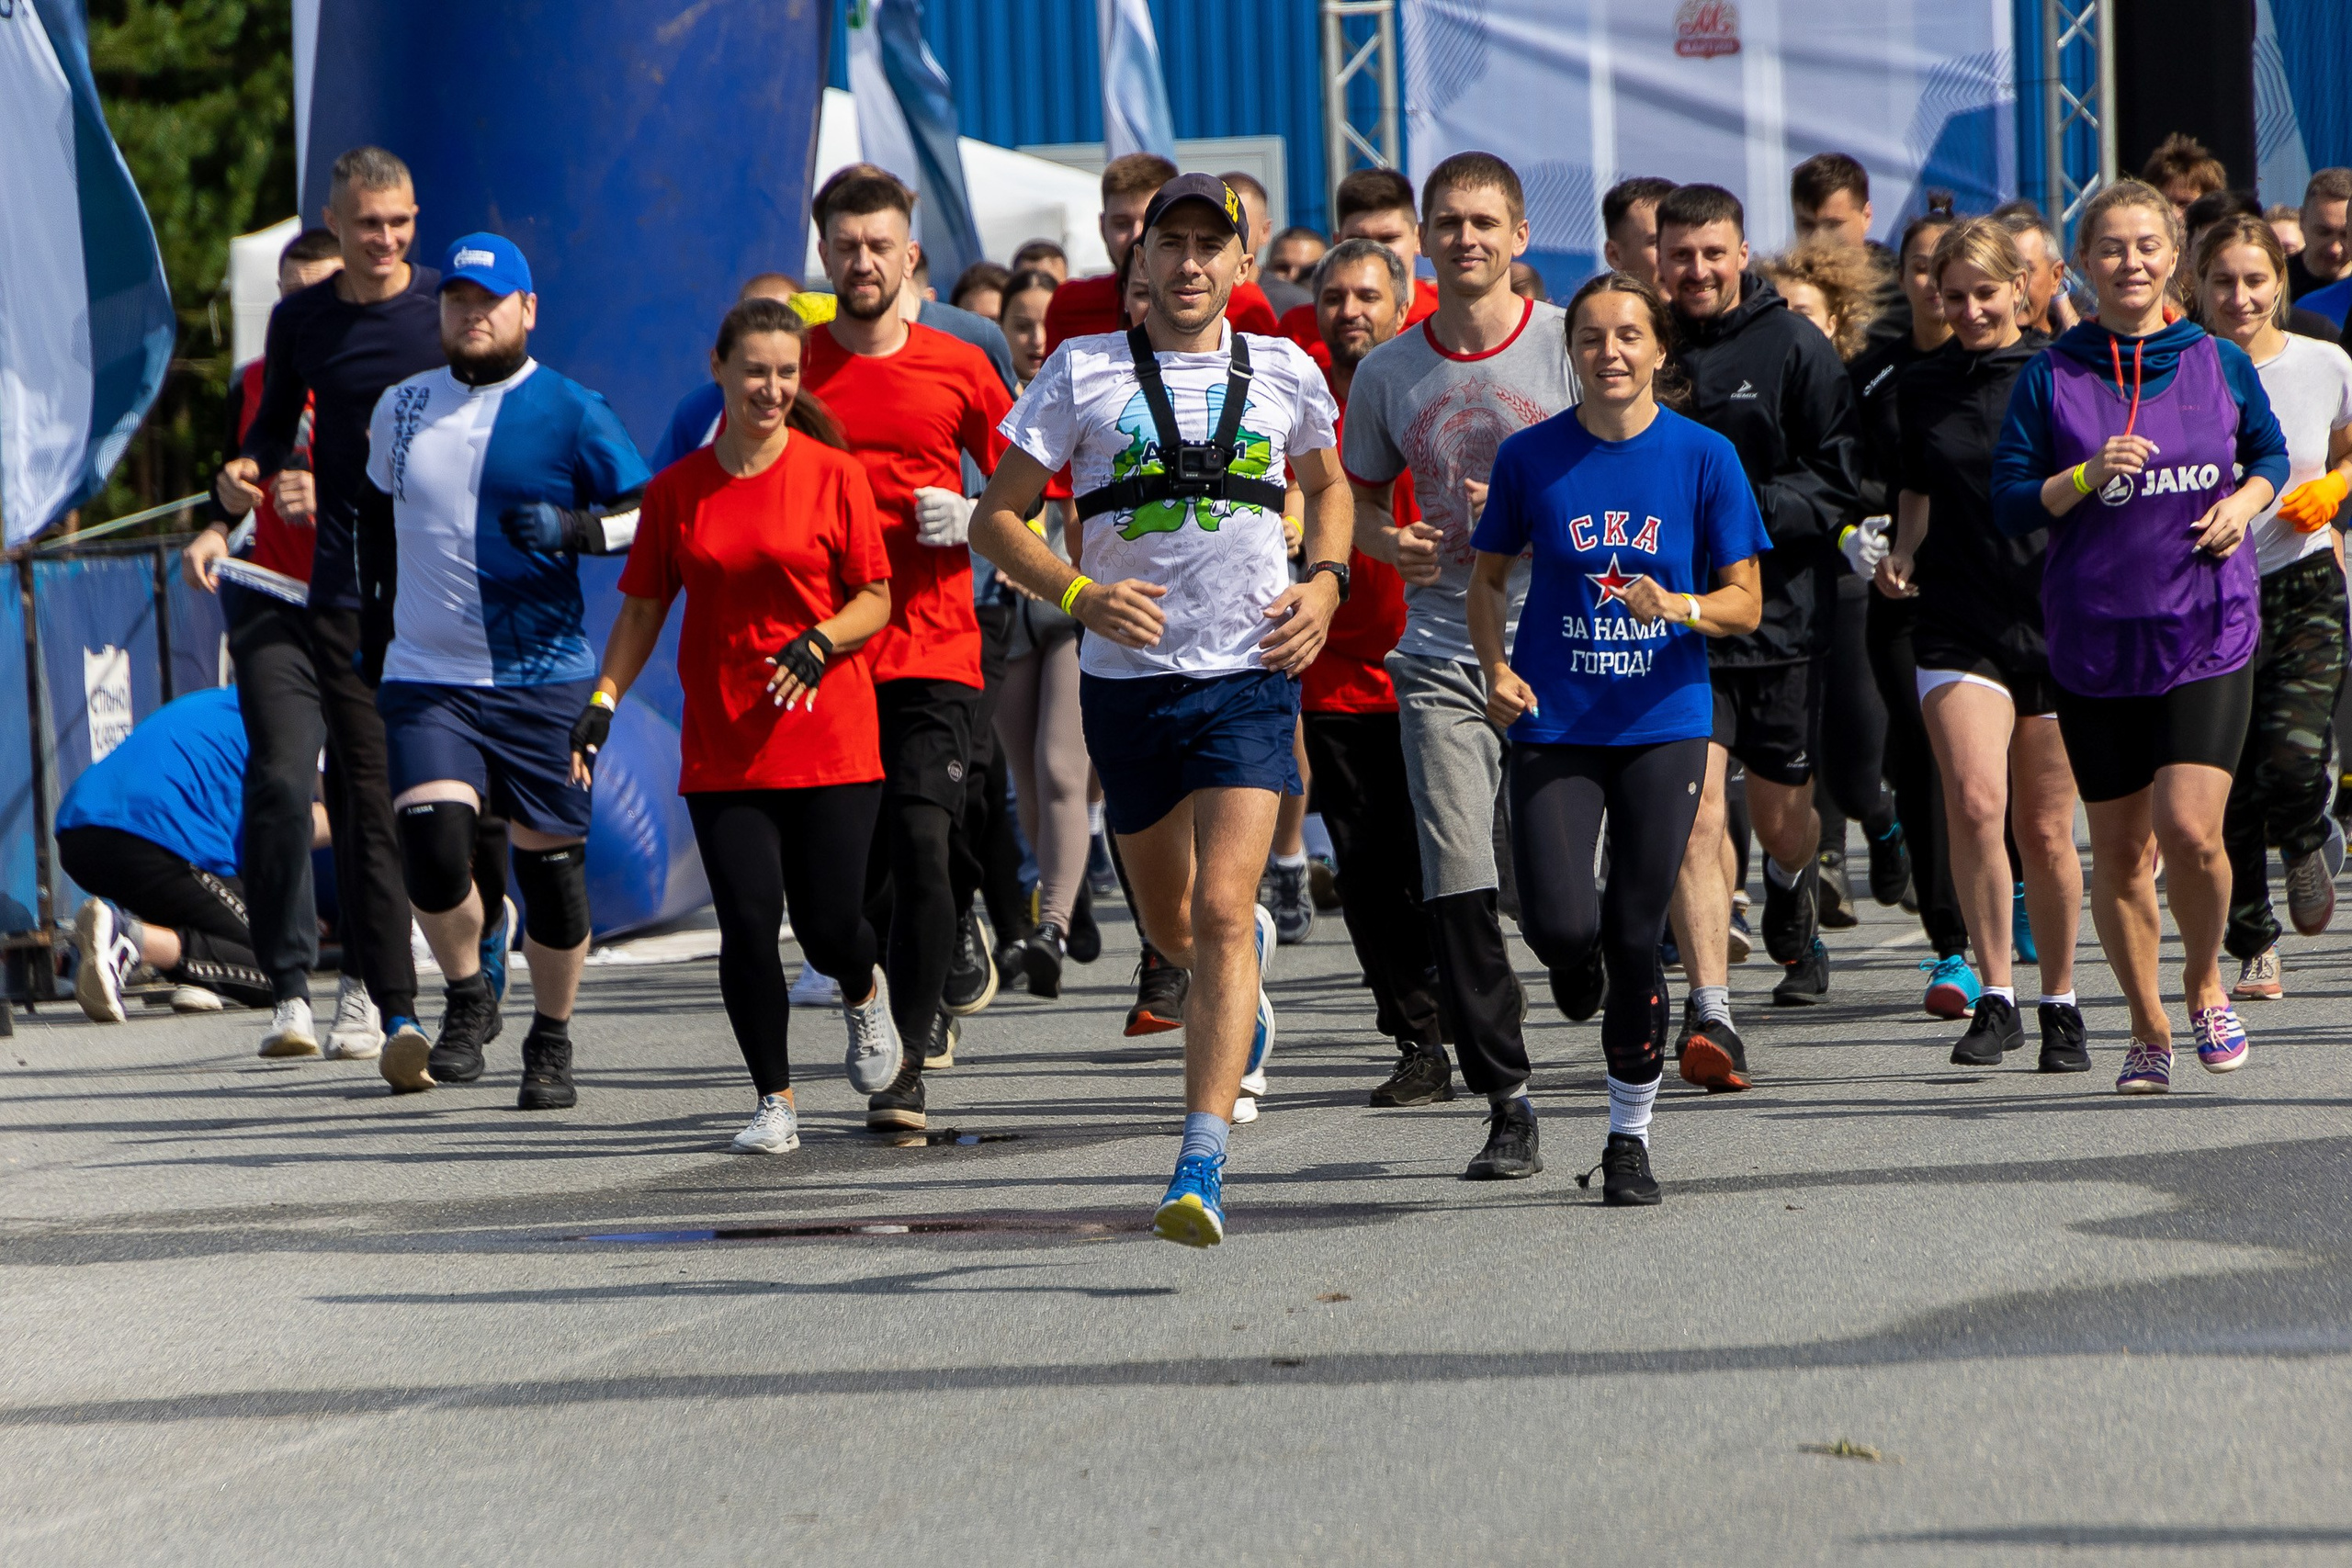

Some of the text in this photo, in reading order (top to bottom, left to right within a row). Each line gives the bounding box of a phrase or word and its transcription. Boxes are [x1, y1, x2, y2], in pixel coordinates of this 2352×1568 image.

[393, 386, 430, 503] ХАРАКТЕР
[2142, 463, 2220, 497] JAKO
[1568, 511, 1662, 555] СКА
[1562, 615, 1668, 641] ЗА НАМИ
[1570, 649, 1654, 678] ГОРОД!
